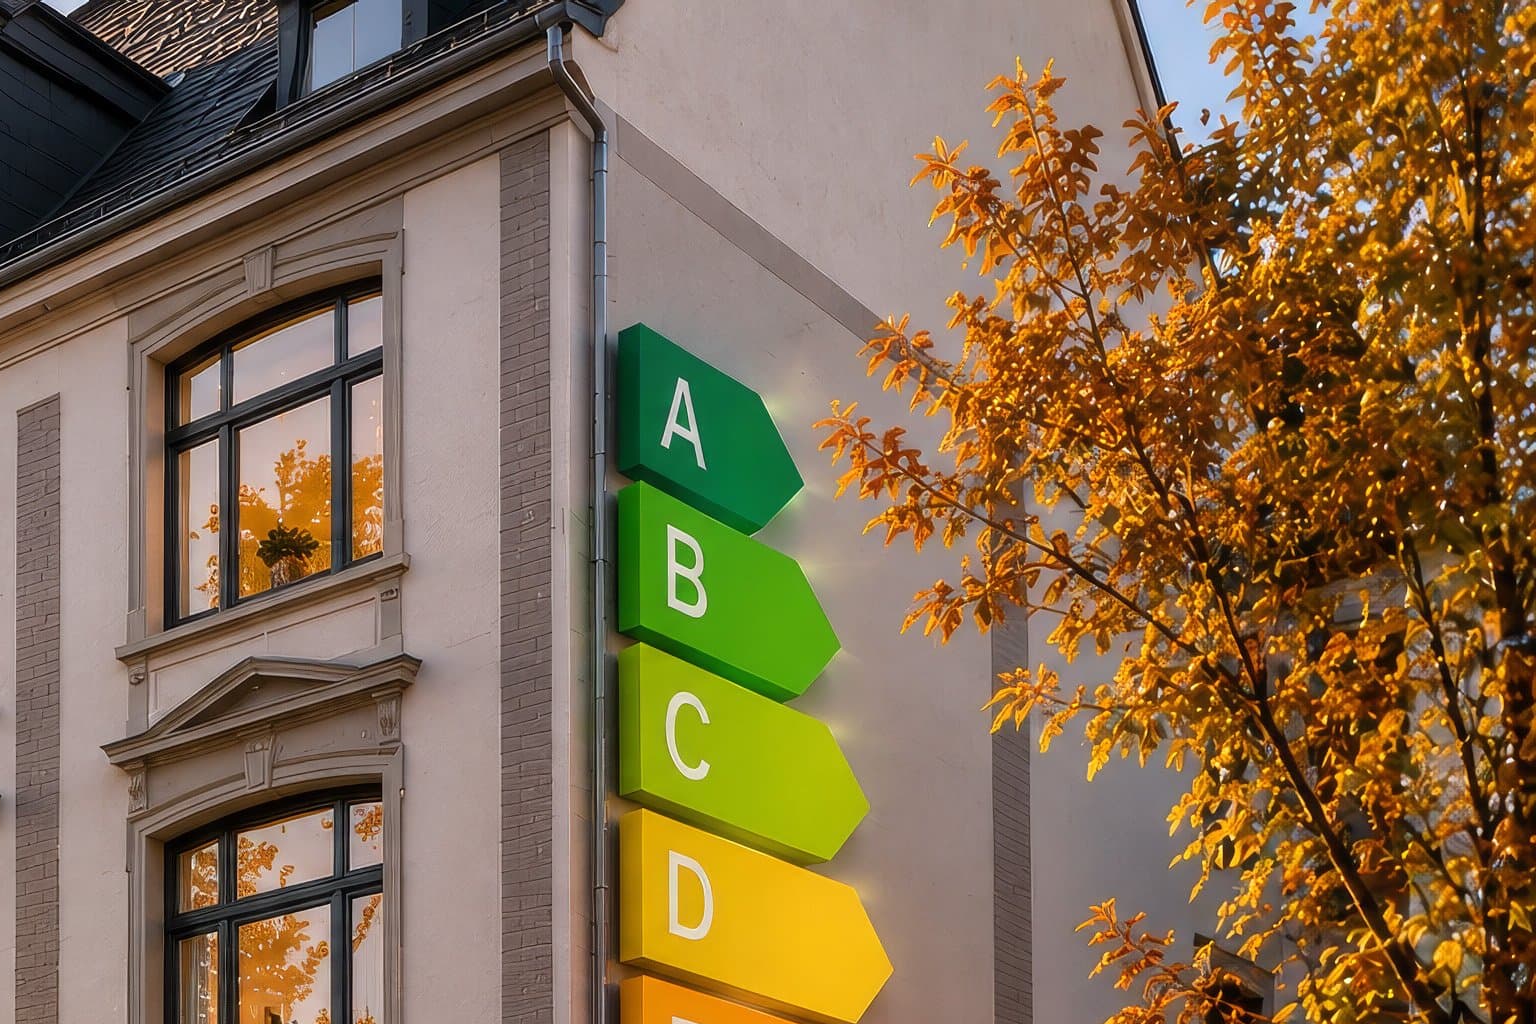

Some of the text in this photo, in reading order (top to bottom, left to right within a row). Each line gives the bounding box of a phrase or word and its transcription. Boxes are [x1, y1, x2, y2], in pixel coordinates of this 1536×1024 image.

[660, 376, 707, 471] A
[667, 524, 707, 618] B
[666, 691, 710, 780] C
[669, 850, 713, 940] D
